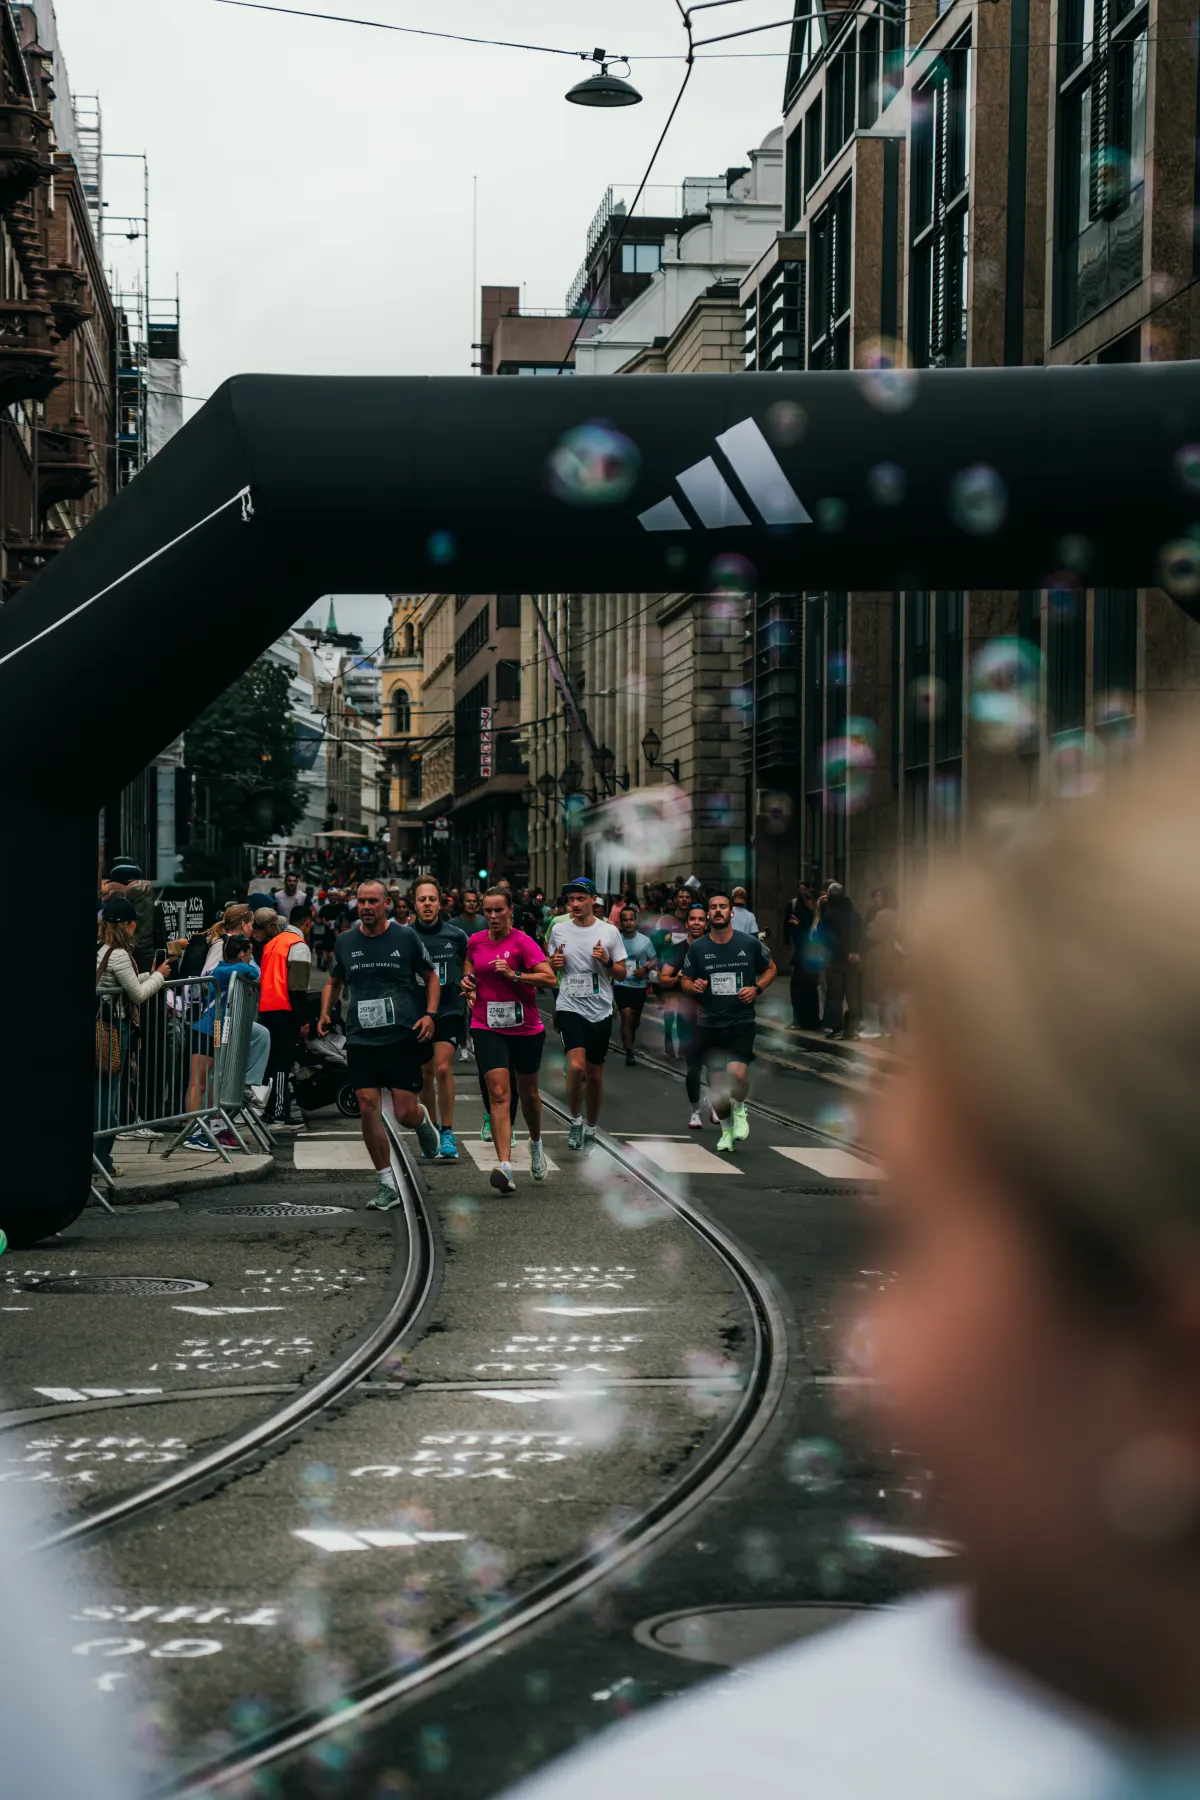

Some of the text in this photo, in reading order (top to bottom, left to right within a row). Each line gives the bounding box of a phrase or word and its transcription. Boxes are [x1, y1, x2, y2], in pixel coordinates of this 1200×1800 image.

[189, 896, 204, 911] XCX
[181, 1337, 314, 1347] THIS
[175, 1347, 313, 1357] GOT
[473, 1362, 612, 1372] YOU
[25, 1435, 188, 1448] THIS
[420, 1435, 583, 1446] THIS
[407, 1450, 567, 1462] GOT
[349, 1464, 523, 1480] YOU
[69, 1604, 283, 1626] THIS
[70, 1637, 223, 1658] GO
